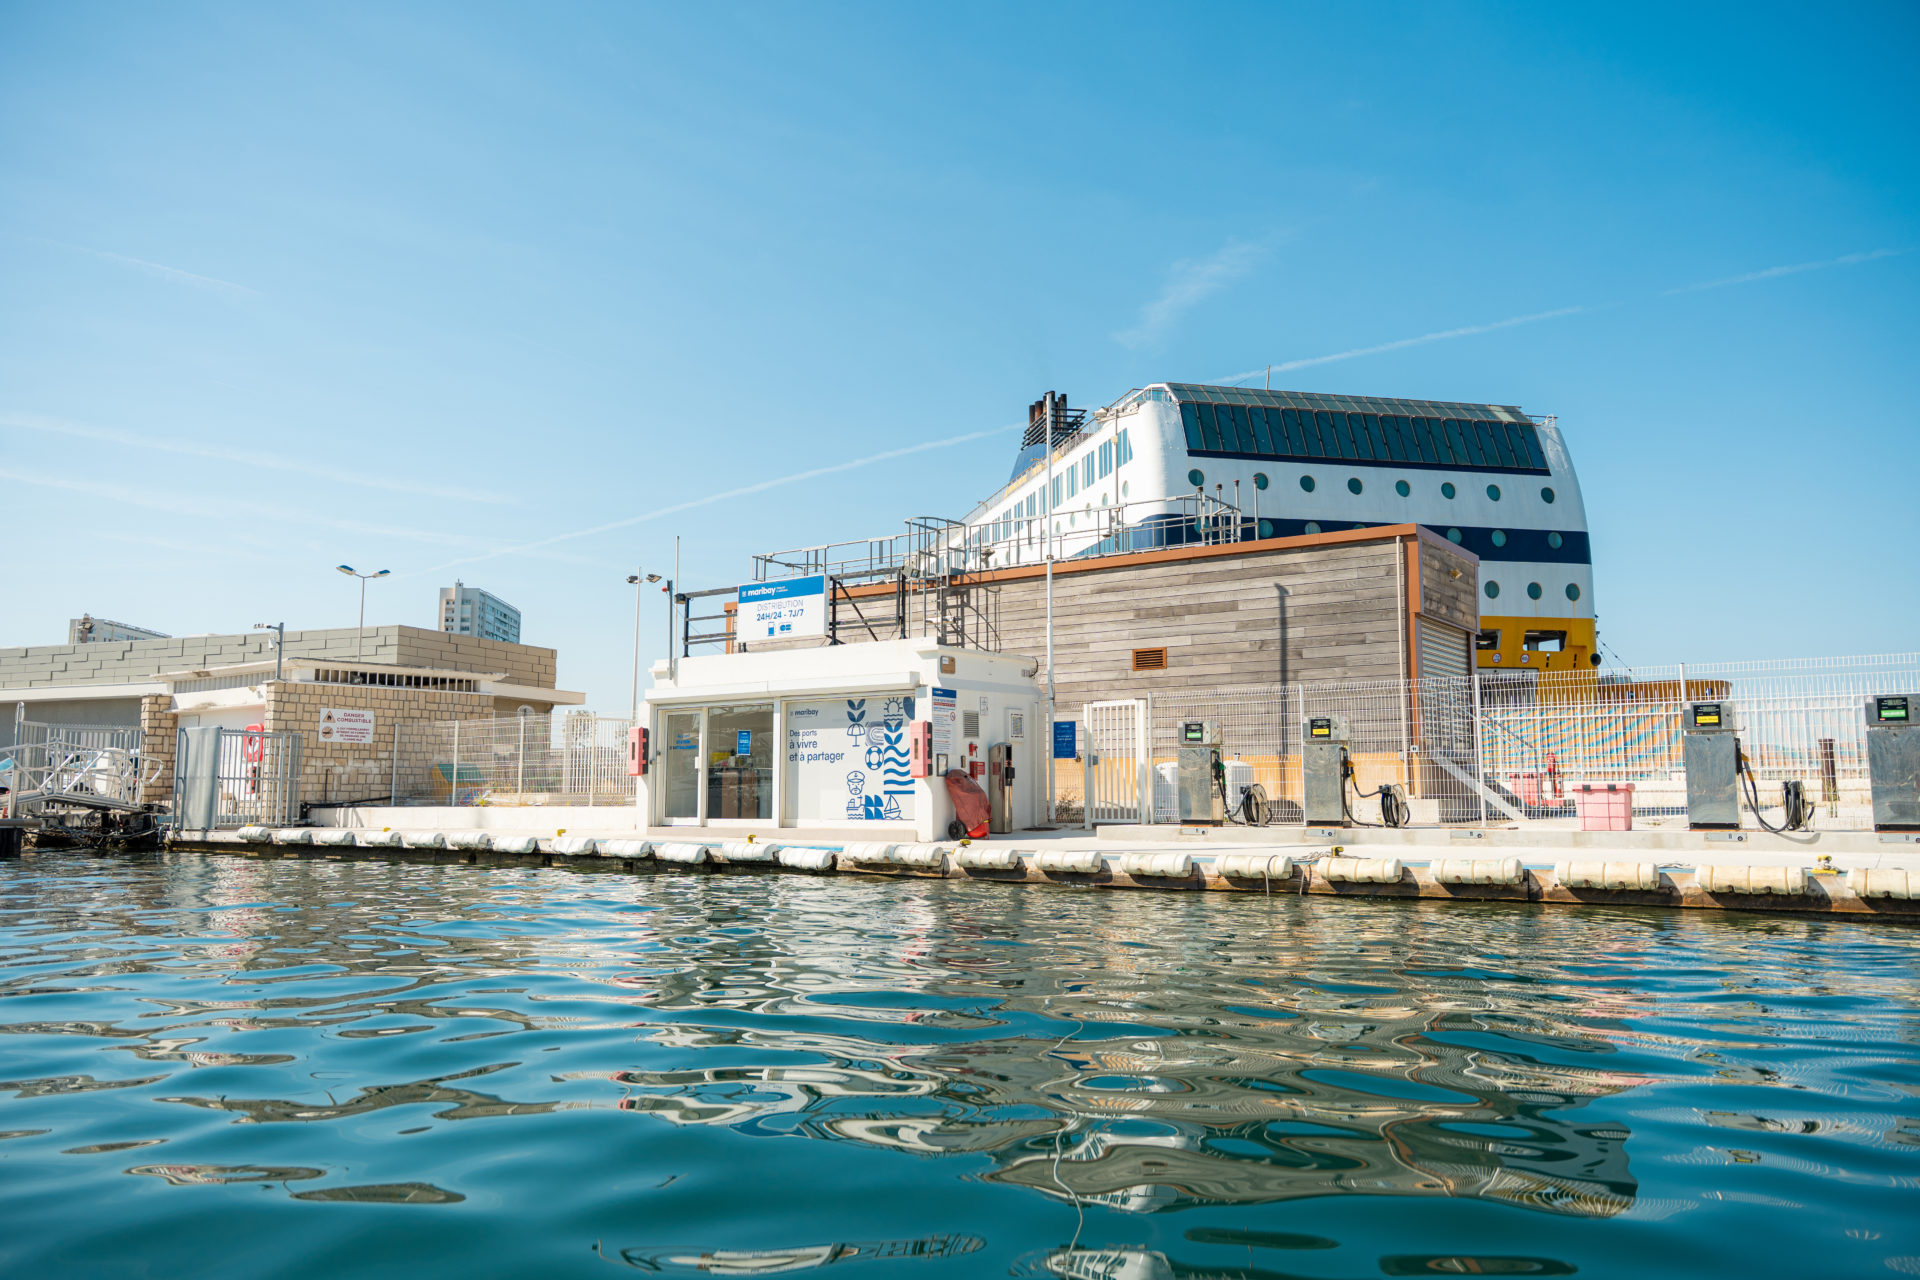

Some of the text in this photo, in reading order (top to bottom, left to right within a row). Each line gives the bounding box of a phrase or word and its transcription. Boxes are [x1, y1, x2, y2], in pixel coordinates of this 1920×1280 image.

[748, 587, 776, 596] maribay
[757, 600, 804, 611] DISTRIBUTION
[757, 611, 782, 621] 24H/24
[788, 608, 804, 618] 7J/7
[802, 730, 818, 738] ports
[789, 739, 818, 749] à vivre
[789, 752, 845, 764] et à partager
